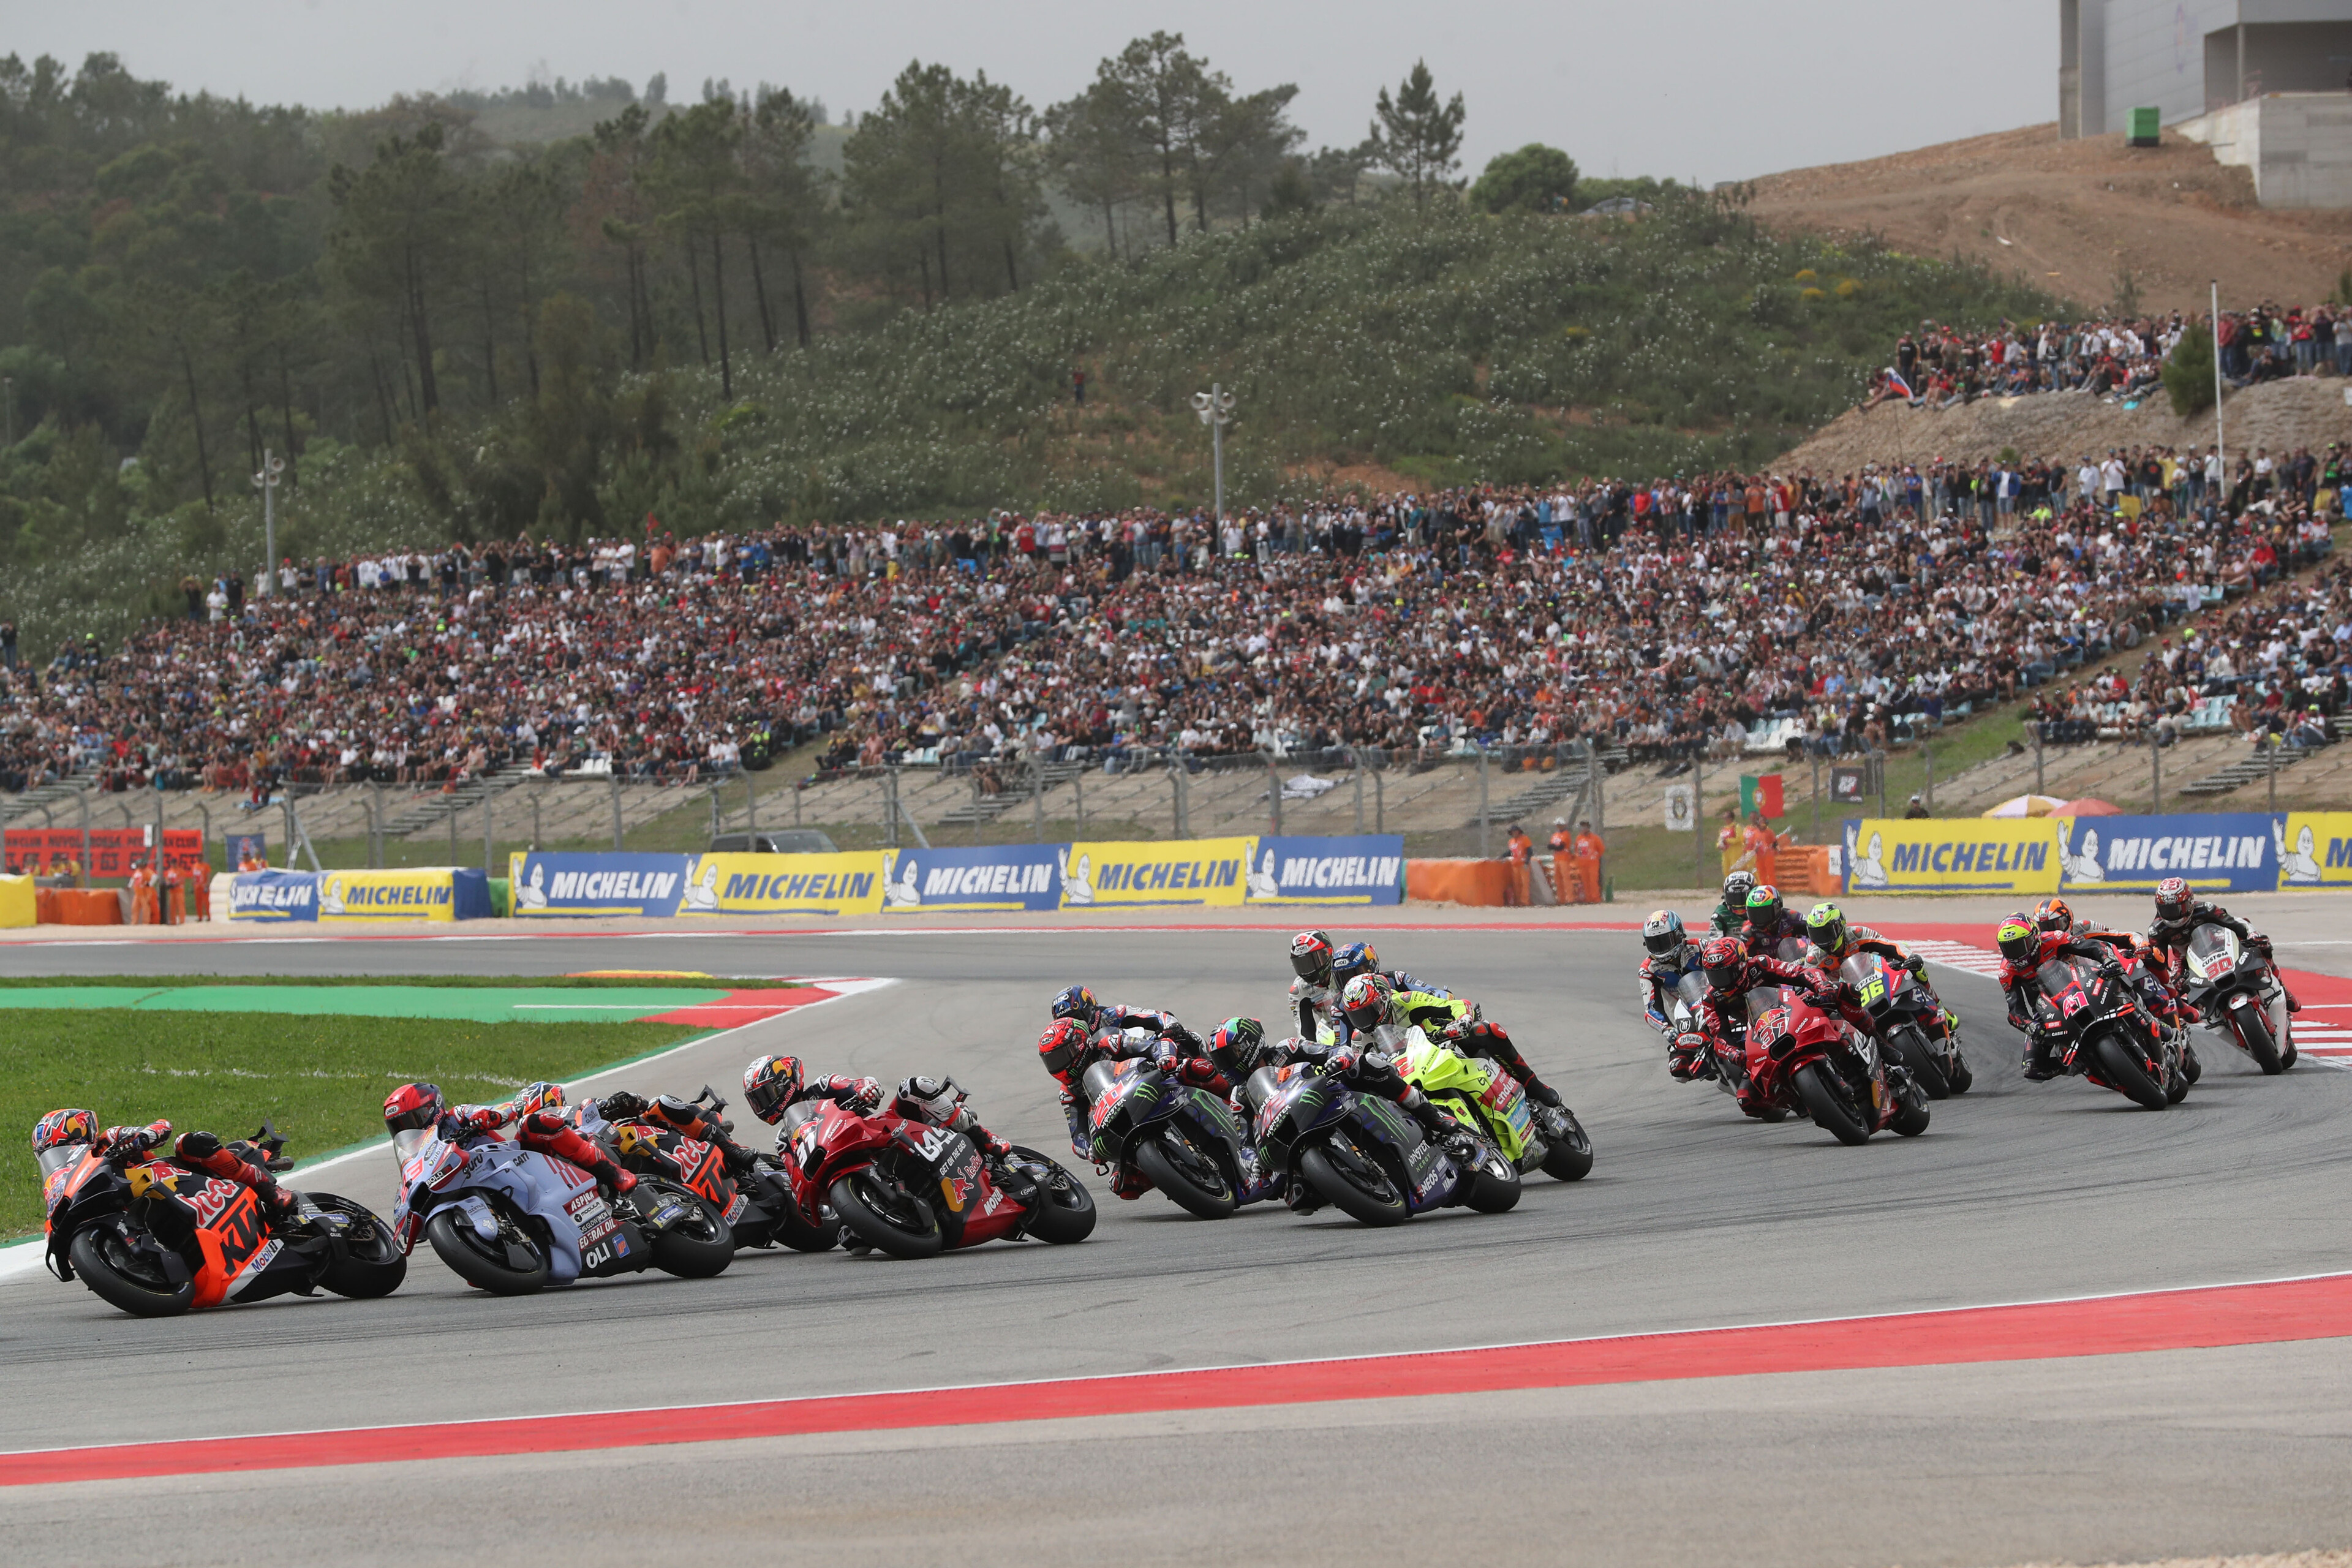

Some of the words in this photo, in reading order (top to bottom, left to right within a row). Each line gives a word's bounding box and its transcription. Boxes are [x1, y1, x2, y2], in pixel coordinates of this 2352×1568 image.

[1893, 842, 2048, 872] MICHELIN
[2108, 836, 2266, 871] MICHELIN
[924, 864, 1053, 895] MICHELIN
[1097, 860, 1239, 890] MICHELIN
[1280, 856, 1400, 888] MICHELIN
[347, 886, 452, 905] MICHELIN
[550, 872, 677, 899] MICHELIN
[724, 873, 875, 900] MICHELIN
[1708, 954, 1724, 963] KYT
[2202, 951, 2228, 967] CUSTOM
[2206, 957, 2234, 981] 30
[2238, 951, 2250, 965] GIVI
[1855, 974, 1879, 990] EPSOL
[1860, 979, 1885, 1008] 36
[2062, 990, 2090, 1020] 41
[1759, 1016, 1790, 1050] 37
[1795, 1017, 1809, 1033] GASGAS
[1679, 1034, 1702, 1044] sterilgarda
[778, 1096, 790, 1110] Red
[787, 1082, 797, 1098] Bull
[1095, 1082, 1116, 1106] ENEOS
[1259, 1089, 1280, 1115] ENEOS
[386, 1106, 398, 1115] SHOEI
[1101, 1098, 1126, 1129] MONSTER
[1266, 1104, 1292, 1137] MONSTER
[827, 1118, 843, 1139] GASGAS
[940, 1163, 949, 1175] GET
[949, 1156, 956, 1167] ON
[957, 1139, 967, 1153] GAS!
[1408, 1139, 1430, 1167] ONSTER
[1415, 1152, 1431, 1172] NERGY
[425, 1170, 443, 1188] BOLD
[570, 1190, 595, 1212] ASPIRA
[725, 1202, 741, 1226] Mobil
[982, 1188, 1005, 1216] MOTUL
[586, 1218, 598, 1230] GLOW
[598, 1211, 608, 1222] MEN
[219, 1197, 268, 1278] KTM
[578, 1227, 605, 1249] EDERAL
[251, 1245, 273, 1273] Mobil
